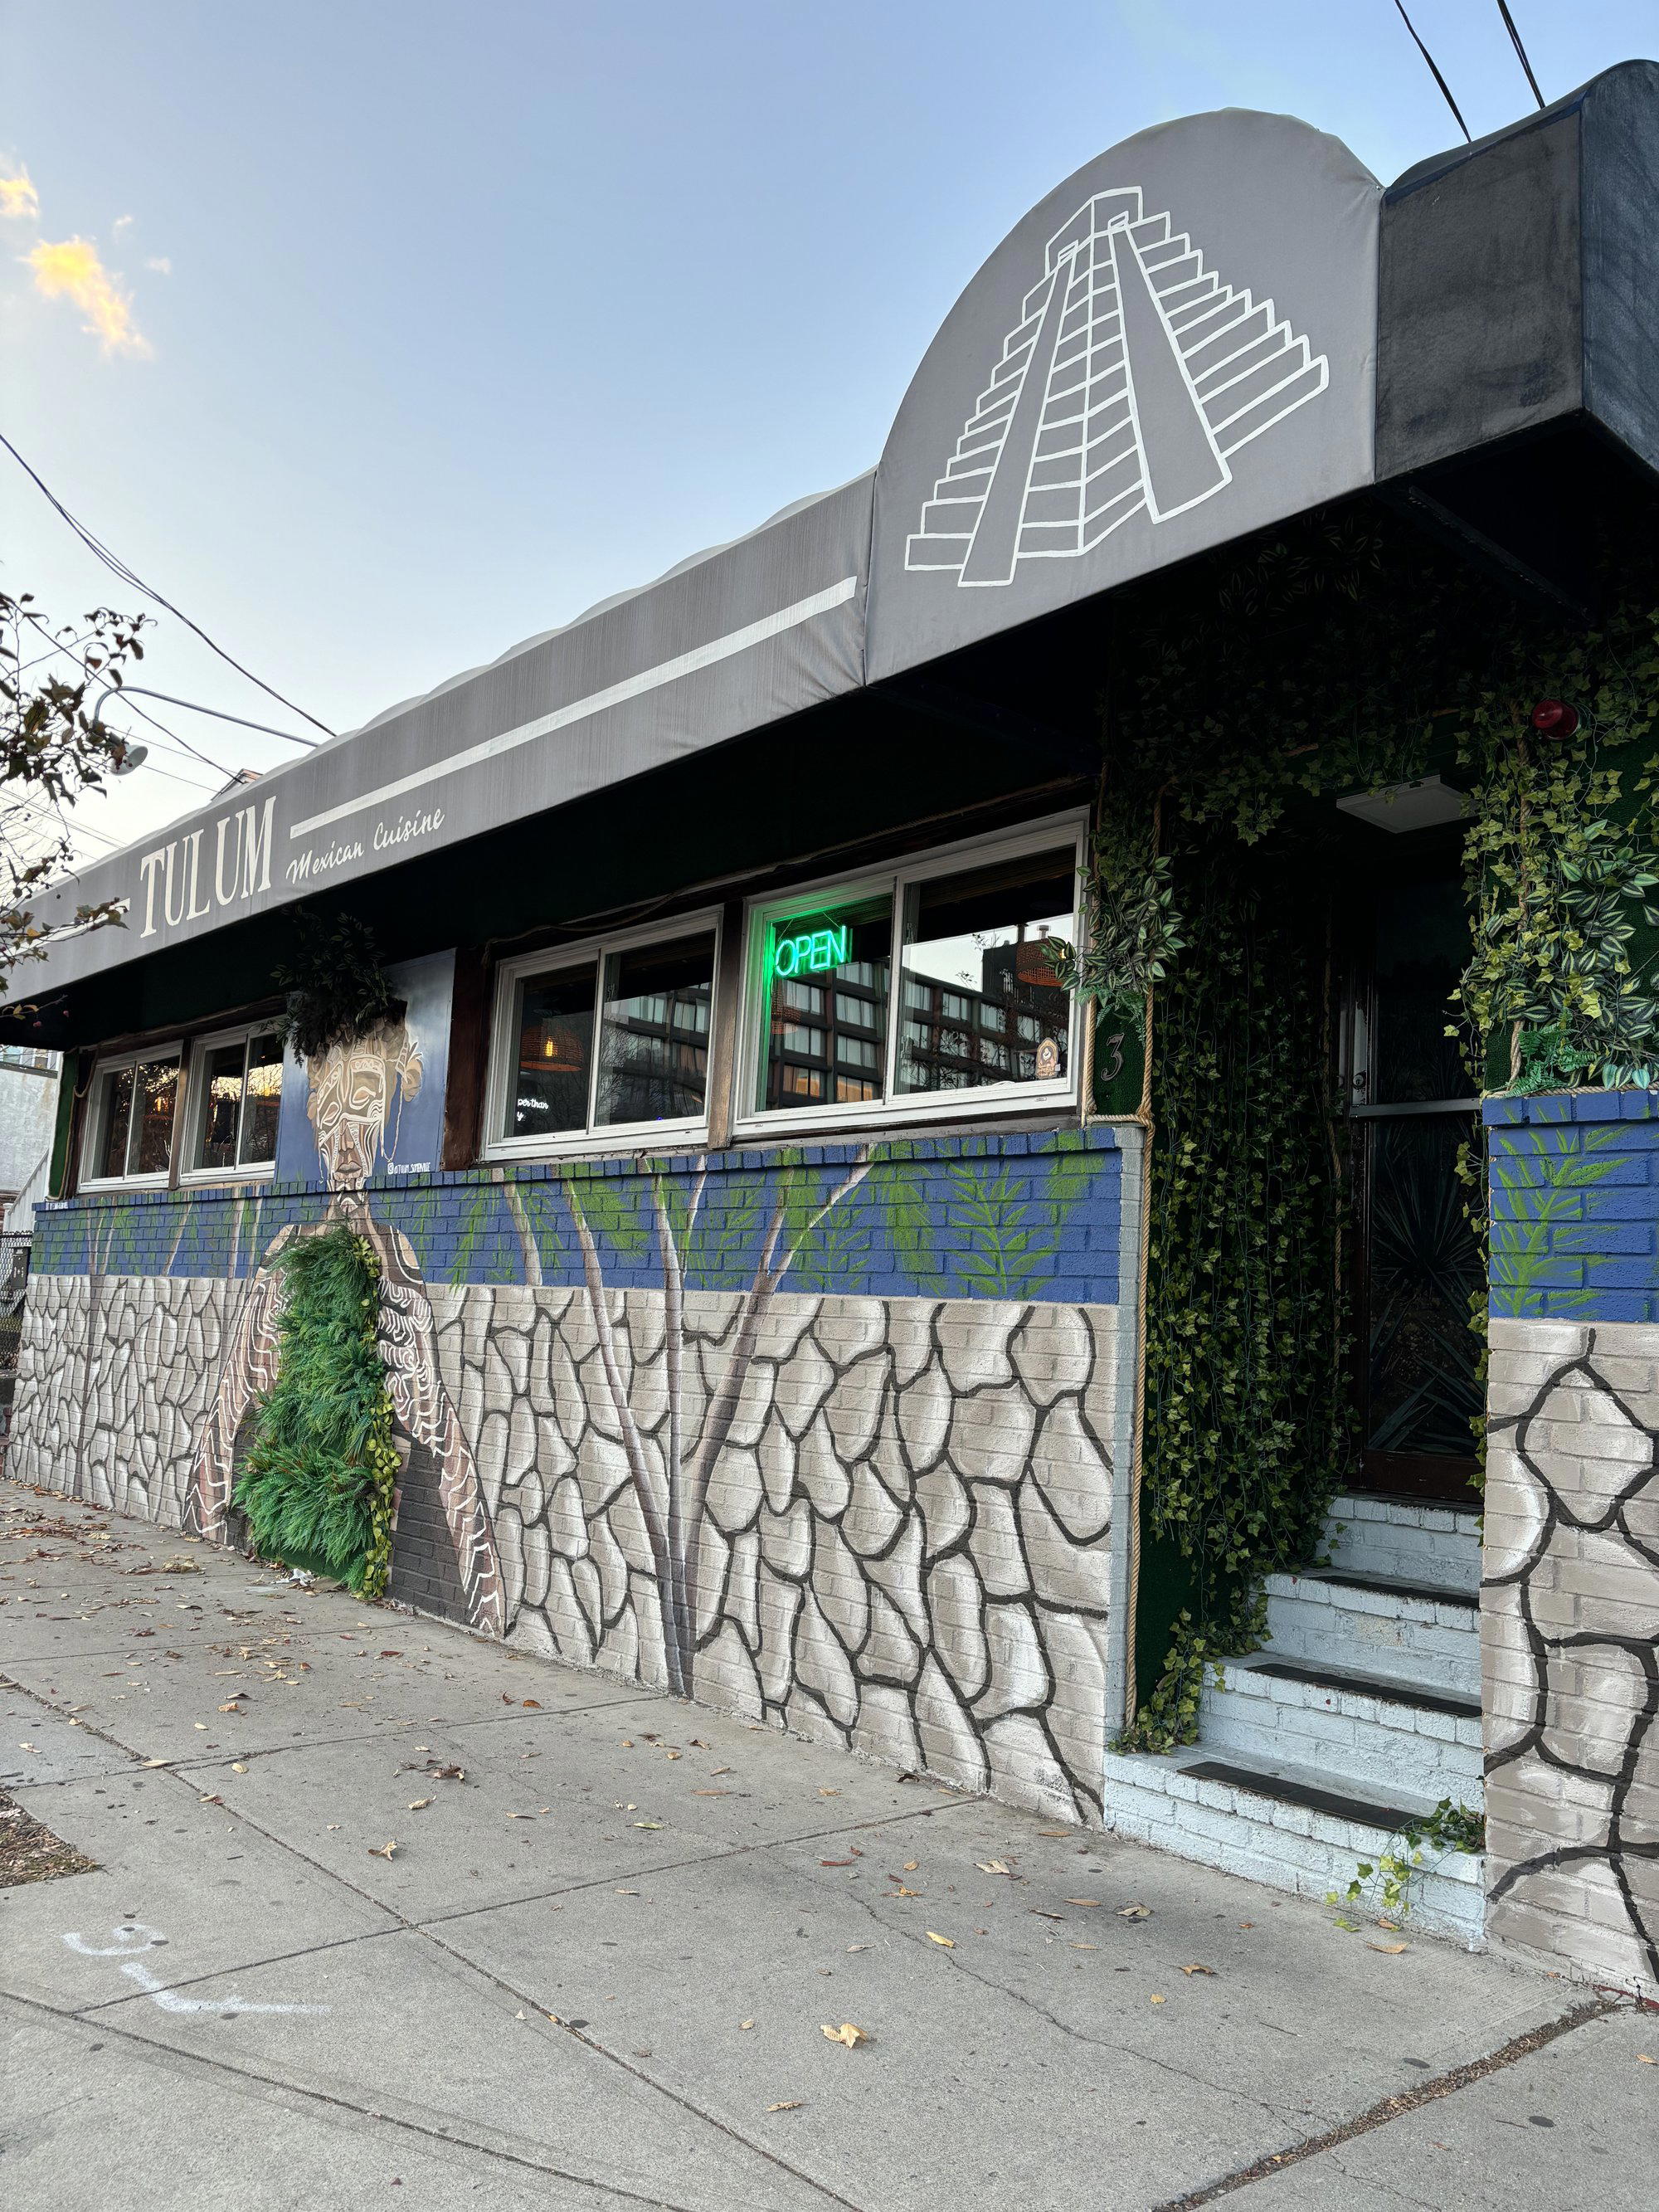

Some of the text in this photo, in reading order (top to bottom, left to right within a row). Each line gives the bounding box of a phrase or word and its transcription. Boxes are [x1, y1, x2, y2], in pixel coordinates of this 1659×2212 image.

[139, 795, 277, 939] TULUM
[285, 807, 445, 884] Mexican Cuisine
[776, 925, 847, 977] OPEN
[1101, 1032, 1125, 1081] 3
